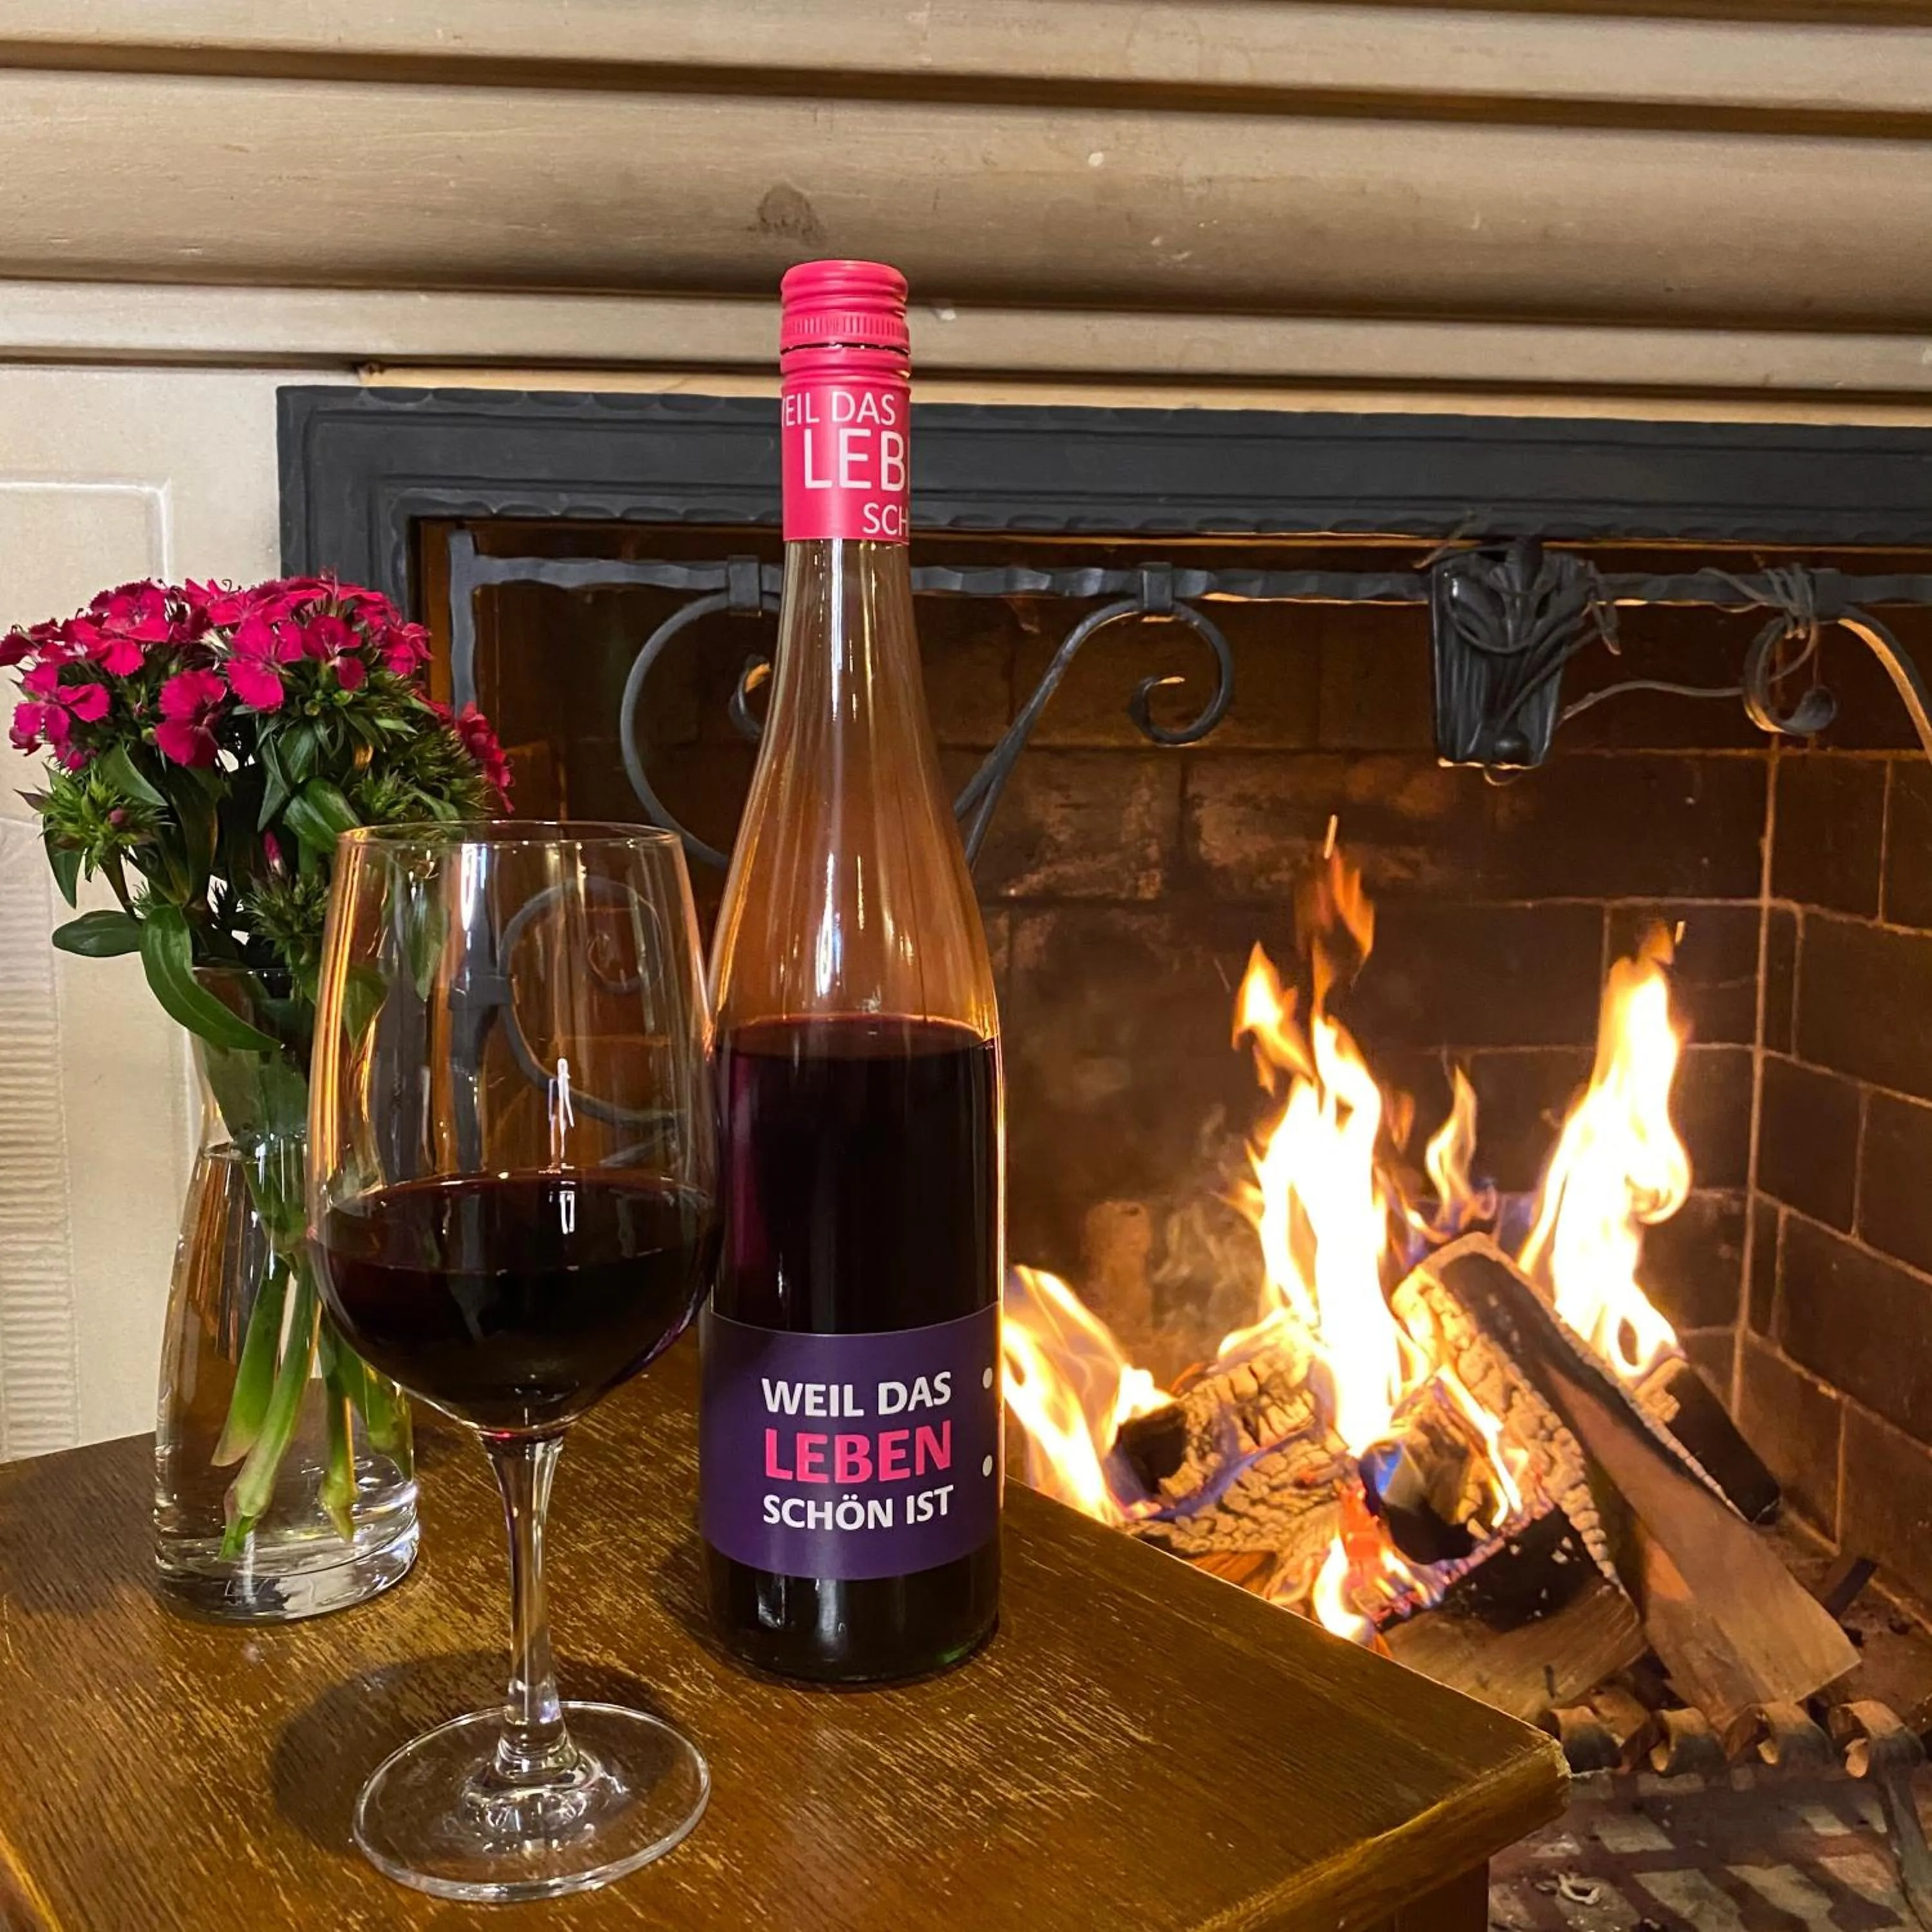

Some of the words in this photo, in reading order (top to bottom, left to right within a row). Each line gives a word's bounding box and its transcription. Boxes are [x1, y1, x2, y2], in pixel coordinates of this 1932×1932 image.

[782, 392, 820, 428] EIL
[831, 391, 896, 426] DAS
[804, 428, 910, 495] LEB
[761, 1378, 864, 1417] WEIL
[877, 1371, 951, 1415] DAS
[764, 1419, 952, 1484] LEBEN
[763, 1494, 893, 1530] SCHÖN
[906, 1484, 954, 1525] IST
